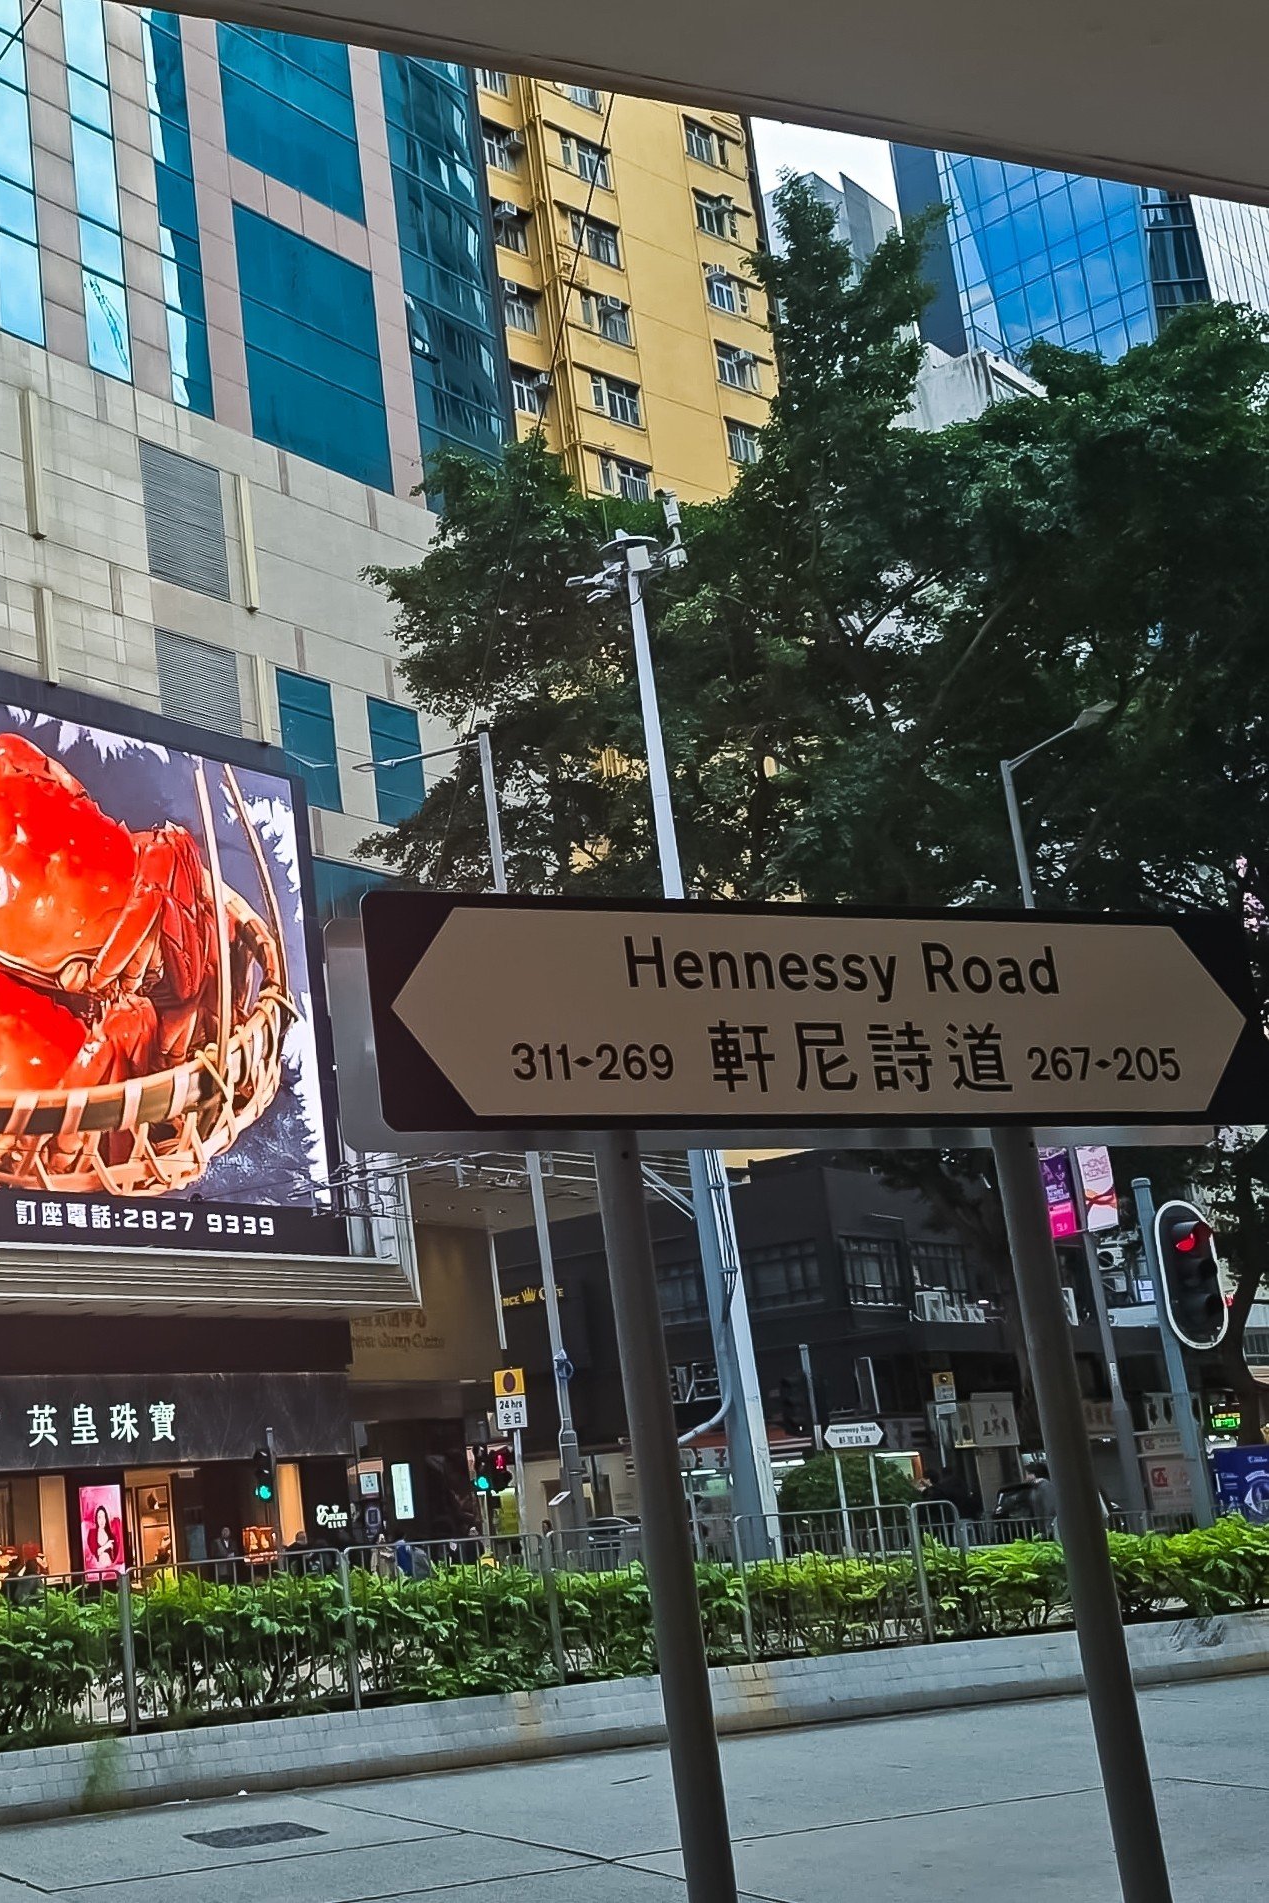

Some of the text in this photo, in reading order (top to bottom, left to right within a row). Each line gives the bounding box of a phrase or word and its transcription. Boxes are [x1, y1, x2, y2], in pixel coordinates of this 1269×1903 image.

[623, 934, 1061, 1003] Hennessy Road
[706, 1018, 1015, 1095] 軒尼詩道
[206, 1213, 276, 1237] 9339
[499, 1399, 523, 1410] 24 hrs
[503, 1411, 522, 1425] 全日
[26, 1400, 178, 1449] 英皇珠寶
